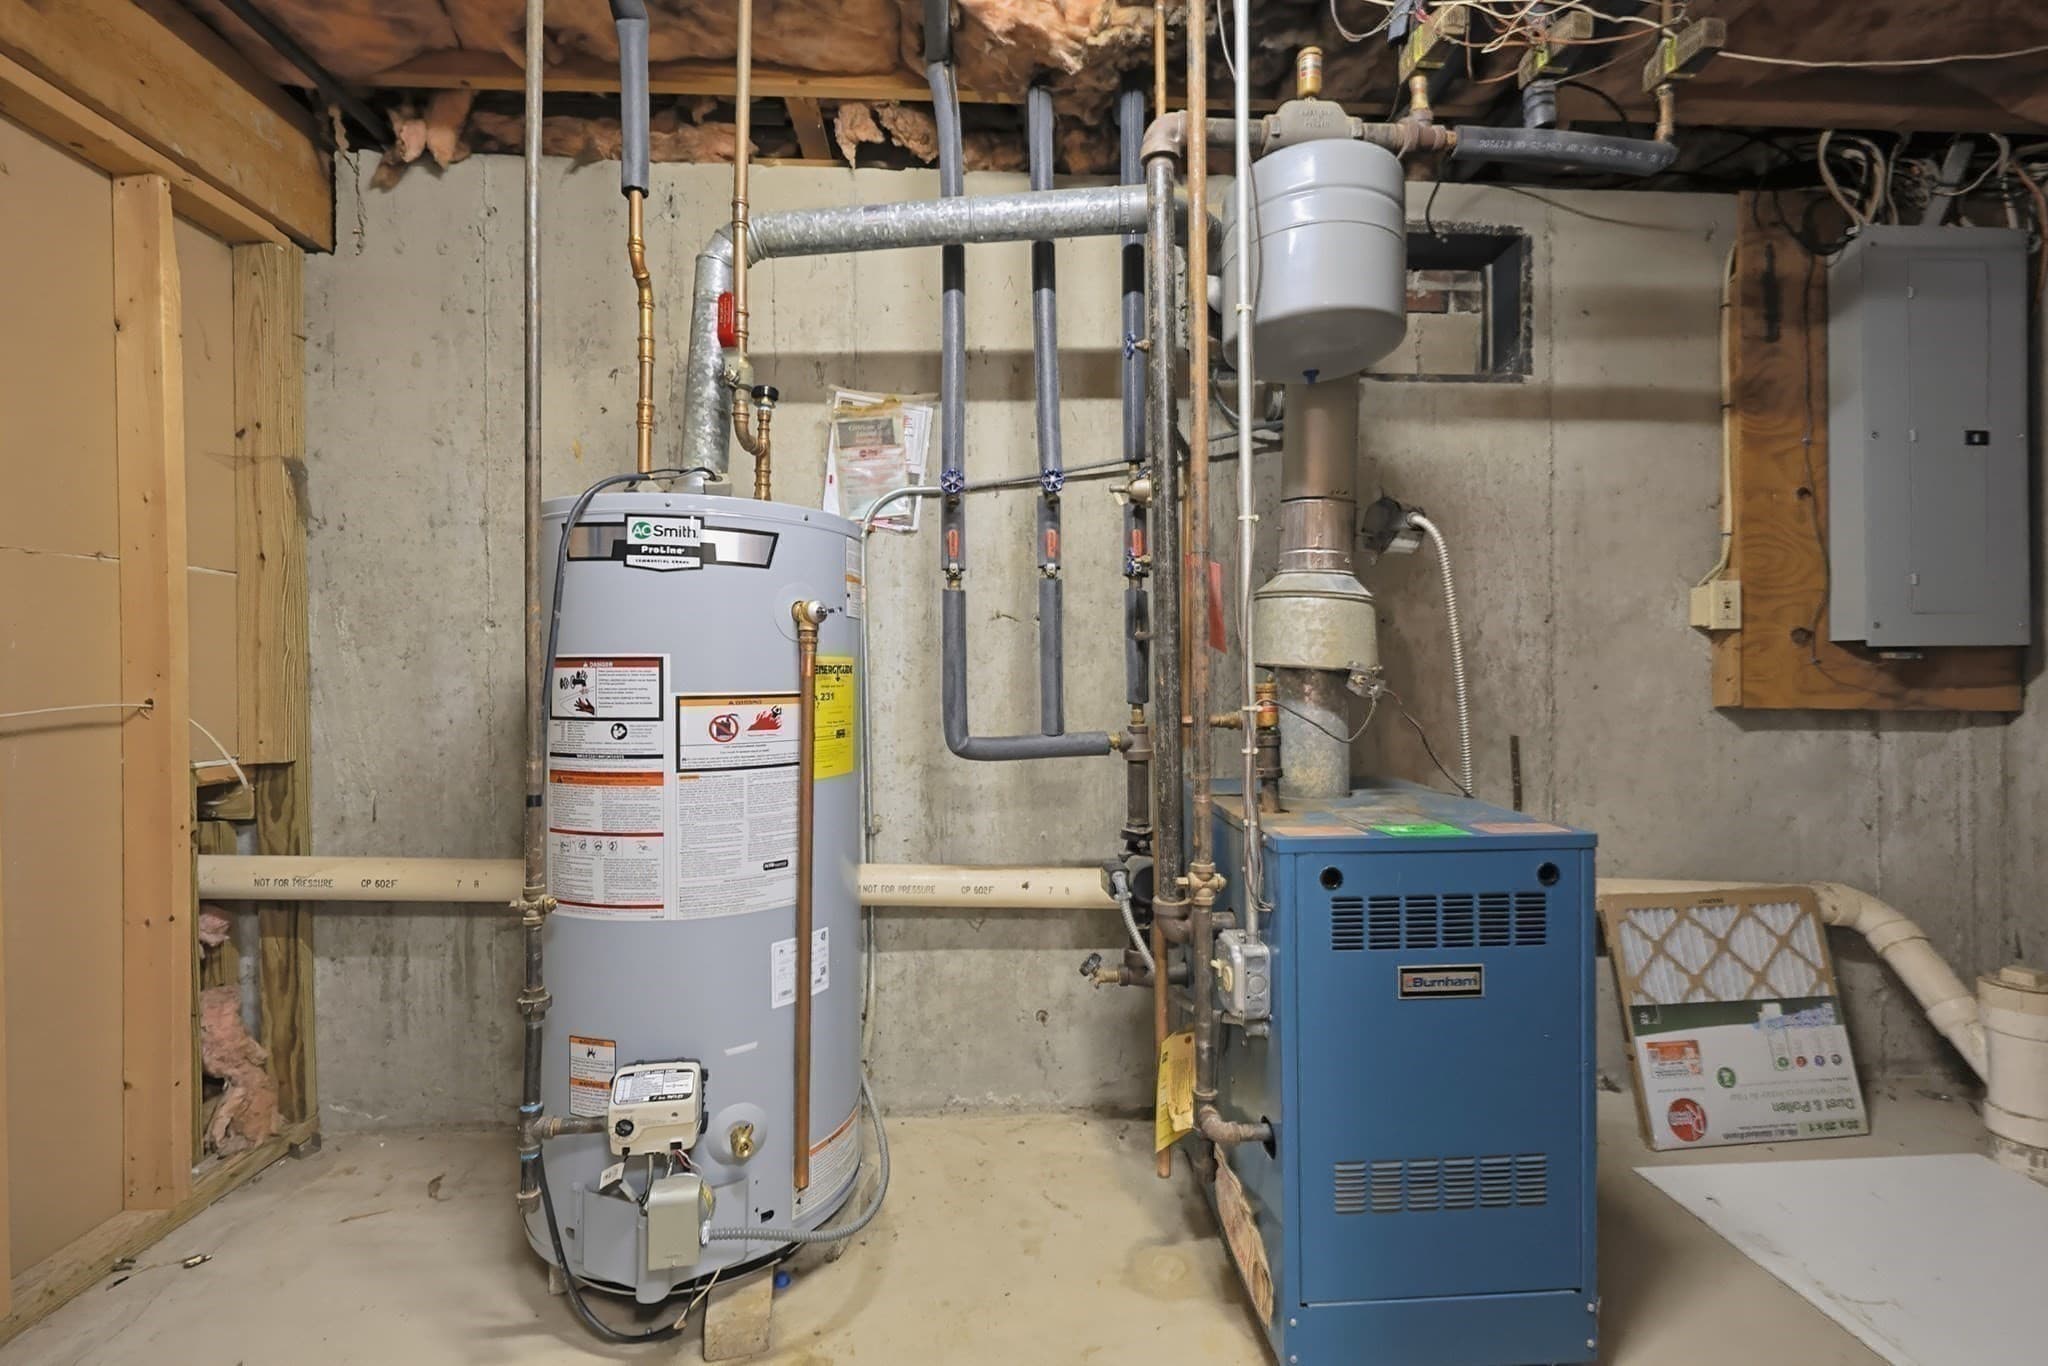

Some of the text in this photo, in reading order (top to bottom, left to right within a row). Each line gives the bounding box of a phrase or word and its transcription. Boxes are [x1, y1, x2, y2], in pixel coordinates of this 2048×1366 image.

[653, 524, 697, 538] Smith
[641, 545, 683, 555] ProLine
[254, 878, 271, 888] NOT
[273, 878, 289, 888] FOR
[292, 878, 334, 888] PRESSURE
[361, 879, 371, 888] CP
[863, 885, 877, 893] NOT
[961, 886, 971, 895] CP
[1412, 976, 1477, 988] Burnham
[1771, 1101, 1811, 1113] Pollen
